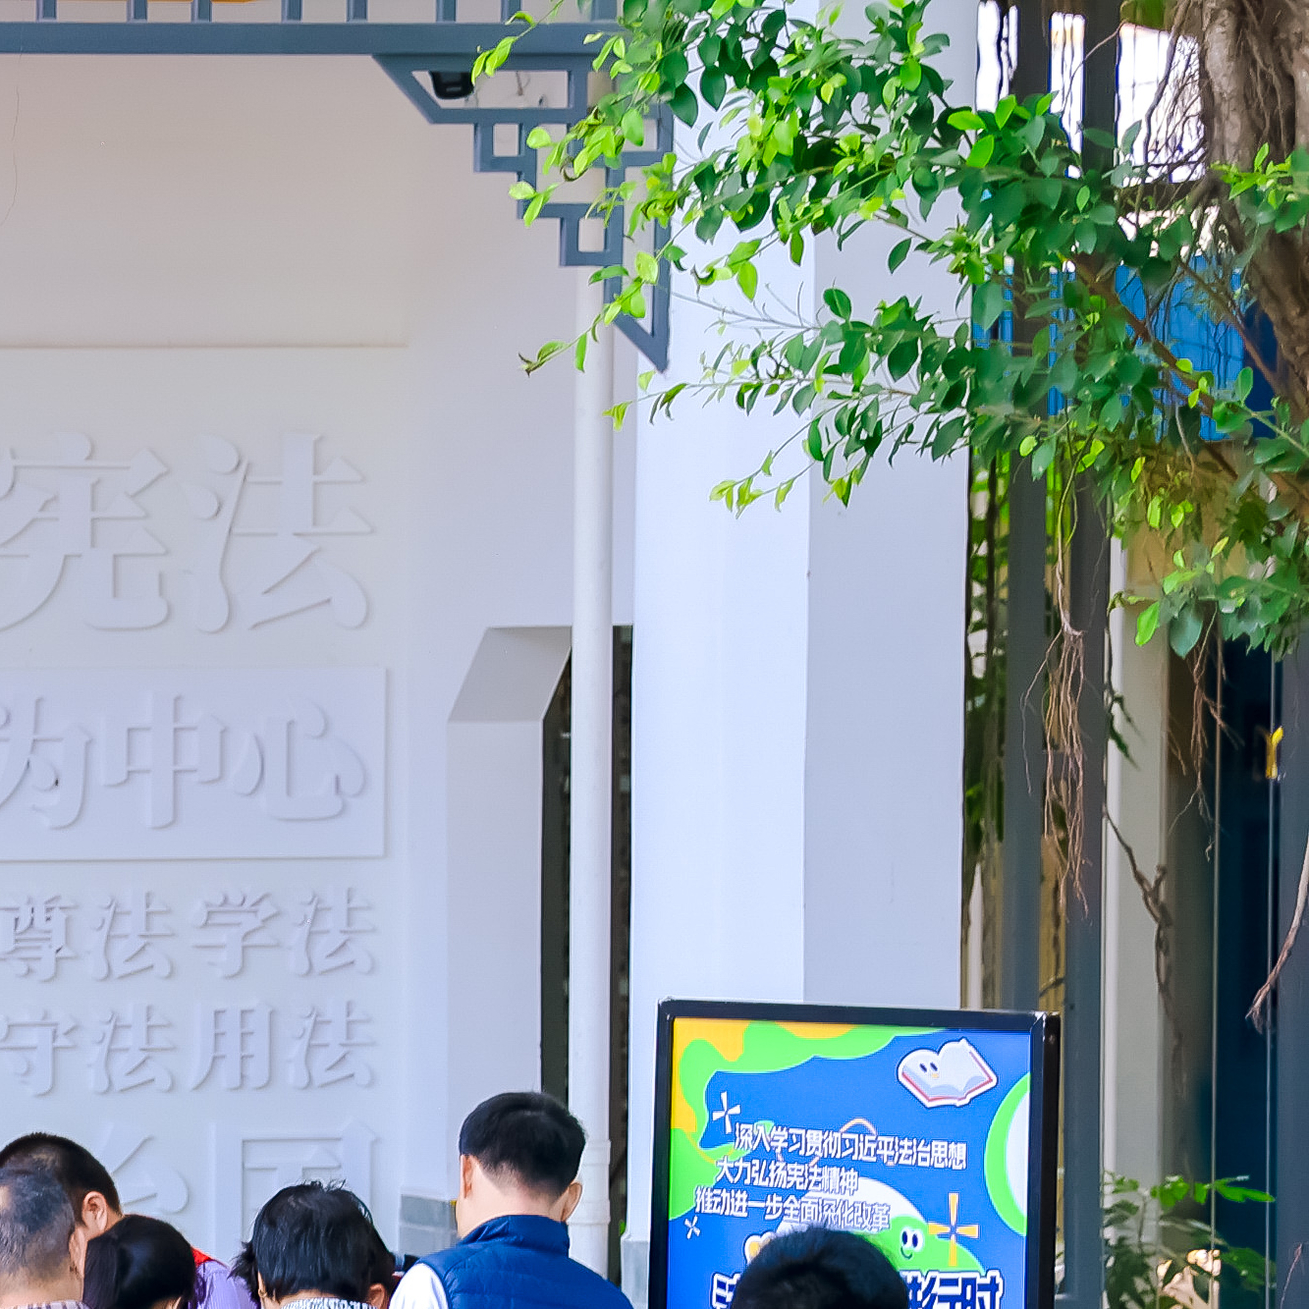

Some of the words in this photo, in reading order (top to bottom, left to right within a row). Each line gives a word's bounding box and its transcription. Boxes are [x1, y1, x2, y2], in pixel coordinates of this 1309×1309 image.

[734, 1122, 968, 1170] 深入学习贯彻习近平法治思想
[716, 1156, 858, 1195] 大力弘扬宪法精神
[694, 1186, 891, 1231] 推动进一步全面深化改革
